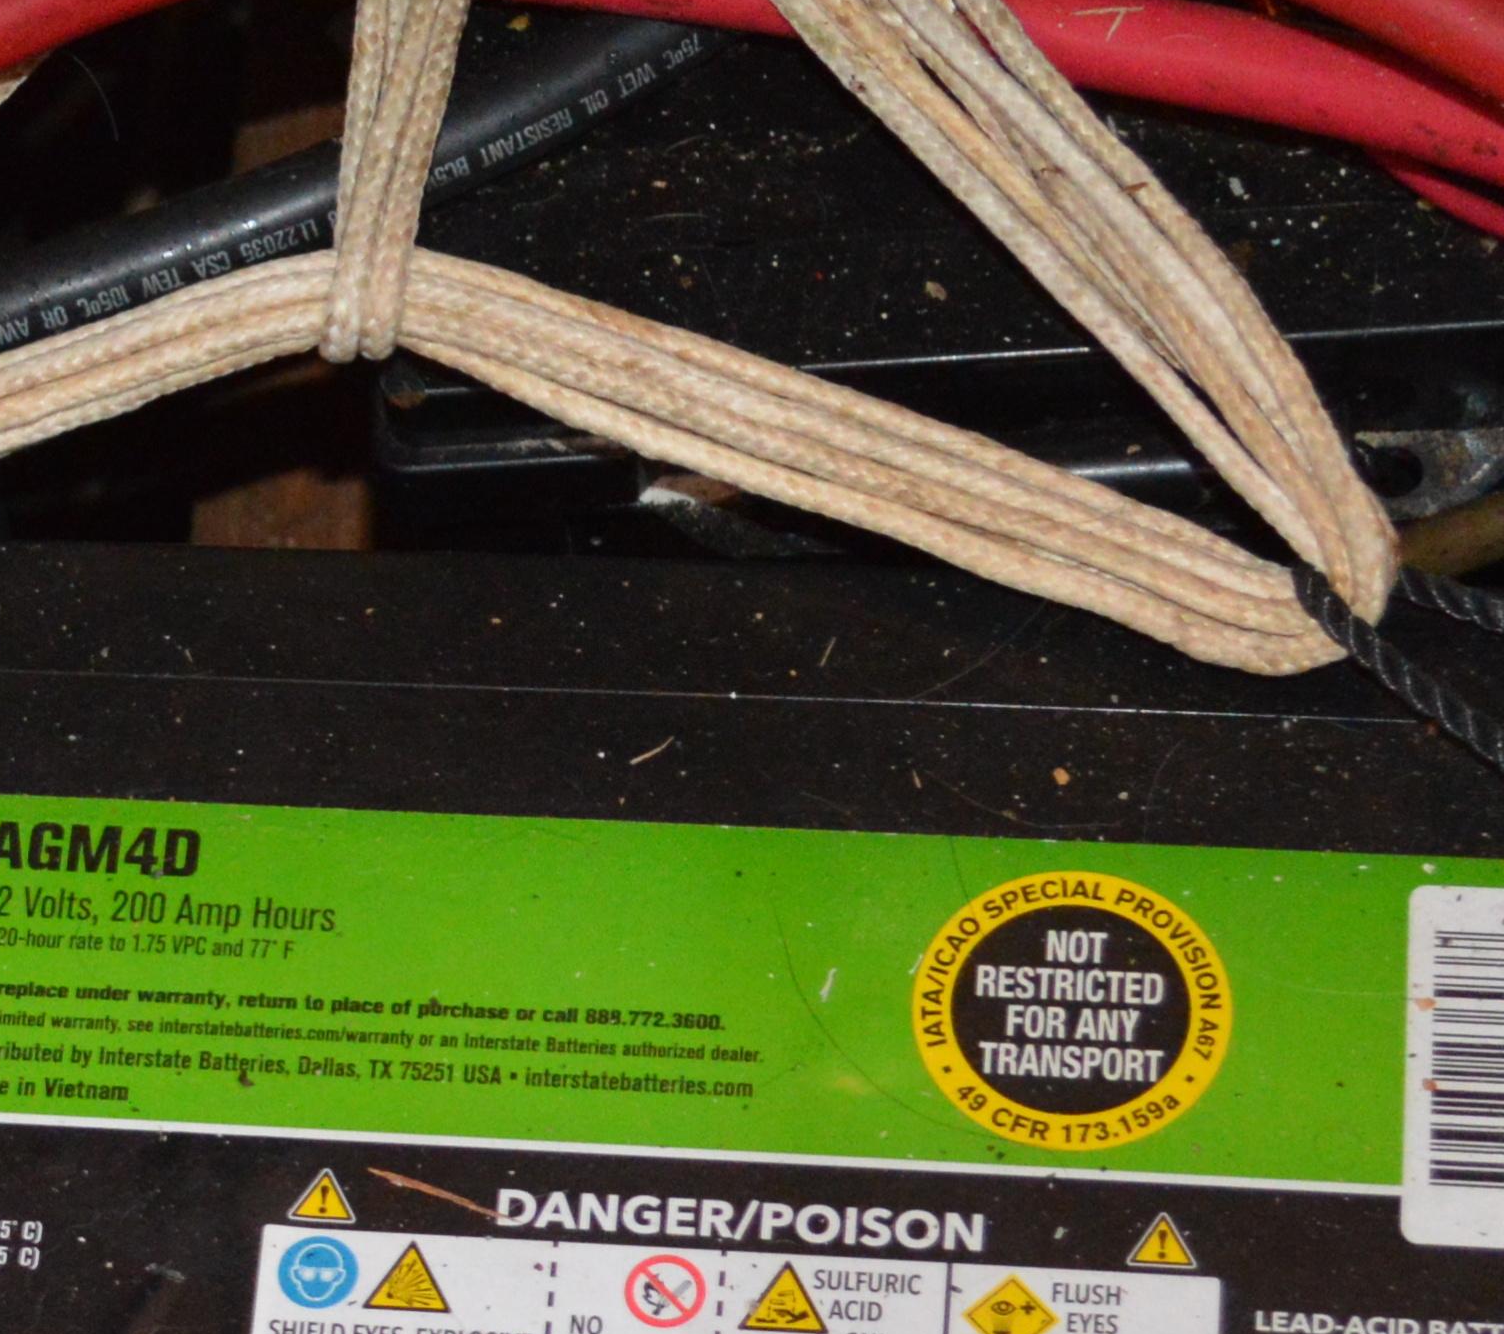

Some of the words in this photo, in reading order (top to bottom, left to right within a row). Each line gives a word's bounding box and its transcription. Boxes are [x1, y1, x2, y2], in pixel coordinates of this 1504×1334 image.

[477, 107, 573, 167] RESISTANT
[137, 263, 185, 298] TEW
[189, 247, 234, 282] CSA
[24, 886, 98, 925] Volts,
[110, 889, 166, 923] 200
[173, 893, 241, 931] Amp
[252, 897, 335, 932] Hours
[1046, 929, 1107, 963] NOT
[921, 916, 981, 1047] IATA/ICAO
[982, 878, 1105, 920] SPECIAL
[1113, 887, 1222, 1011] PROVISION
[1192, 1017, 1220, 1061] A67
[975, 964, 1163, 1004] RESTRICTED
[75, 985, 131, 1001] under
[136, 990, 230, 1009] warranty,
[237, 992, 297, 1009] return
[304, 994, 324, 1011] to
[330, 996, 384, 1014] place
[390, 999, 411, 1015] of
[416, 997, 509, 1020] purchase
[515, 1008, 536, 1020] or
[542, 1007, 578, 1023] call
[584, 1008, 725, 1030] 888.772.3600.
[1006, 1004, 1066, 1038] FOR
[1074, 1008, 1139, 1042] ANY
[50, 1015, 120, 1034] warranty,
[127, 1019, 153, 1032] see
[158, 1018, 413, 1048] interstatebatteries.com/warranty
[418, 1033, 434, 1046] or
[439, 1034, 458, 1047] an
[463, 1033, 540, 1051] Interstate
[545, 1035, 616, 1055] Batteries
[621, 1041, 705, 1060] authorized
[710, 1045, 763, 1062] dealer.
[69, 1044, 92, 1068] by
[98, 1046, 191, 1069] Interstate
[368, 1058, 392, 1079] TX
[399, 1060, 453, 1082] 75251
[463, 1064, 501, 1084] USA
[524, 1067, 753, 1097] interstatebatteries.com
[978, 1040, 1163, 1083] TRANSPORT
[16, 1077, 35, 1096] in
[44, 1077, 128, 1100] Vietnam
[956, 1084, 989, 1112] 49
[991, 1107, 1050, 1141] CFR
[1061, 1093, 1181, 1144] 173.159a
[21, 1220, 42, 1244] C)
[495, 1188, 986, 1252] DANGER/POISON
[813, 1268, 921, 1295] SULFURIC
[1052, 1282, 1121, 1305] FLUSH
[828, 1299, 882, 1321] ACID
[1066, 1312, 1117, 1334] EYES
